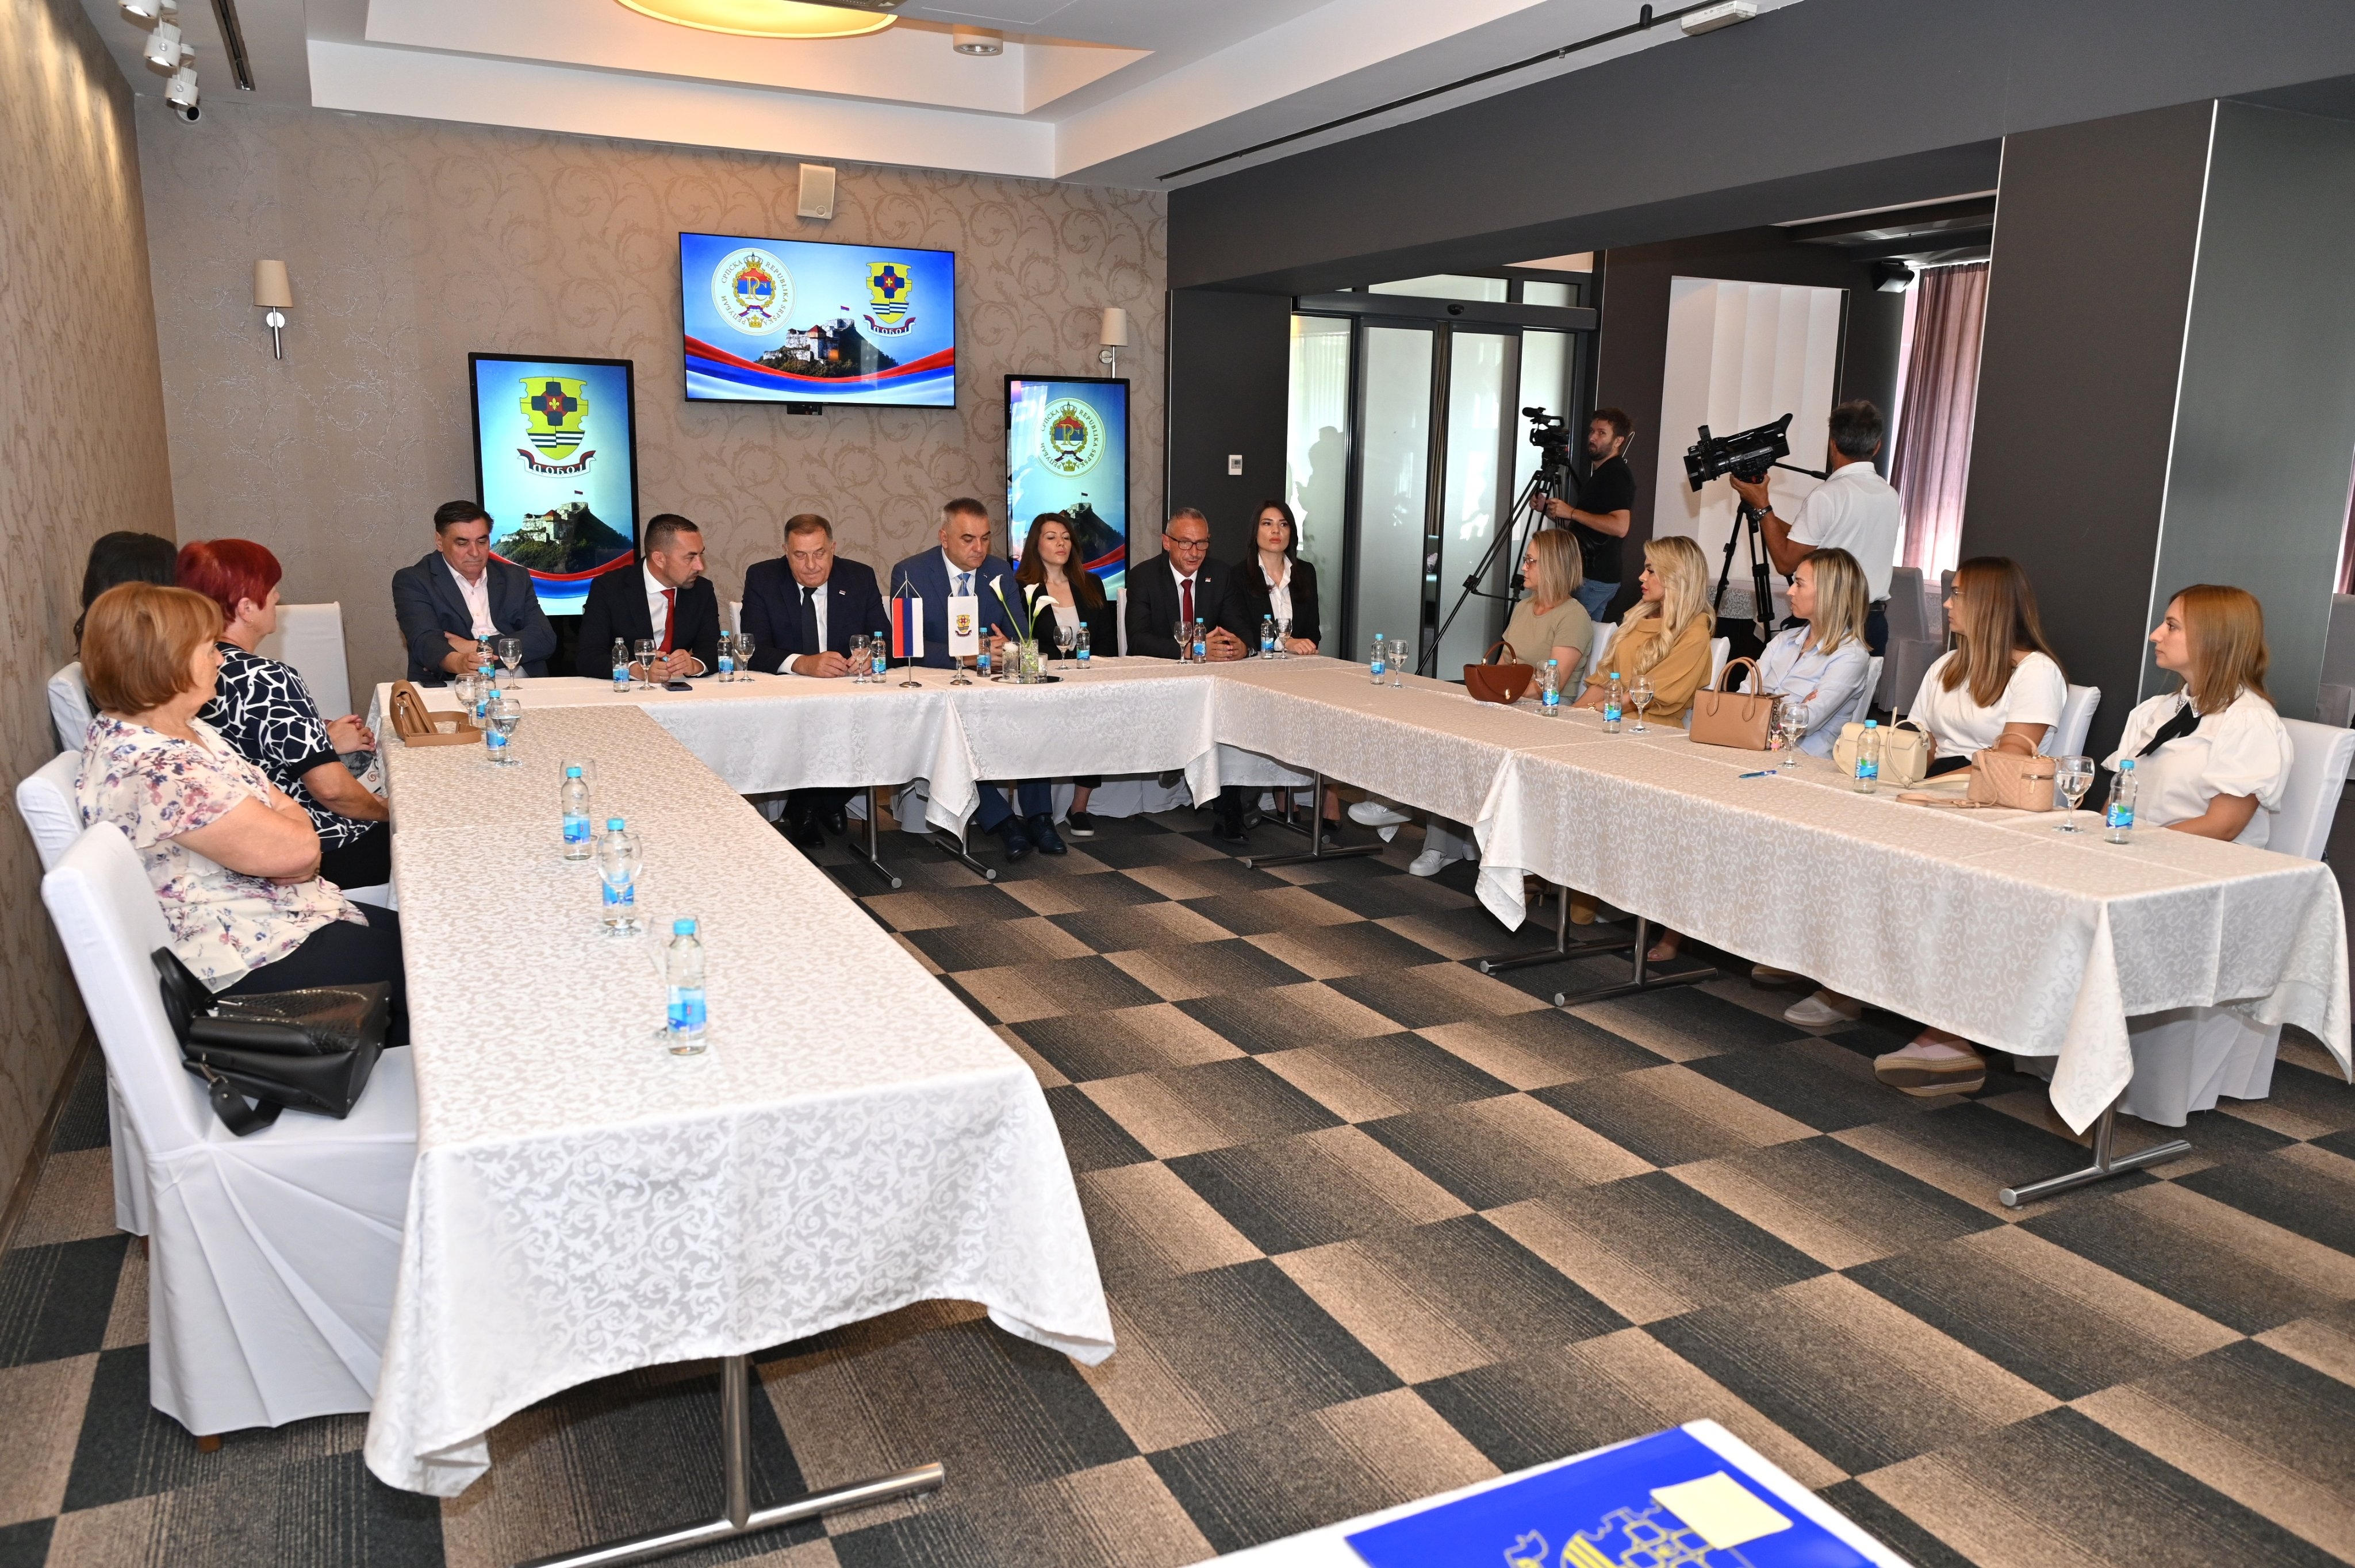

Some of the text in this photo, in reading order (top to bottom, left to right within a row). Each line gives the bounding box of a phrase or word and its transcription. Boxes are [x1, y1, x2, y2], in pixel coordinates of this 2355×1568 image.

[722, 260, 743, 284] СРПСКА
[763, 261, 789, 326] REPUBLIKA SRPSKA
[1076, 409, 1099, 470] REPUBLIKA SRPSKA
